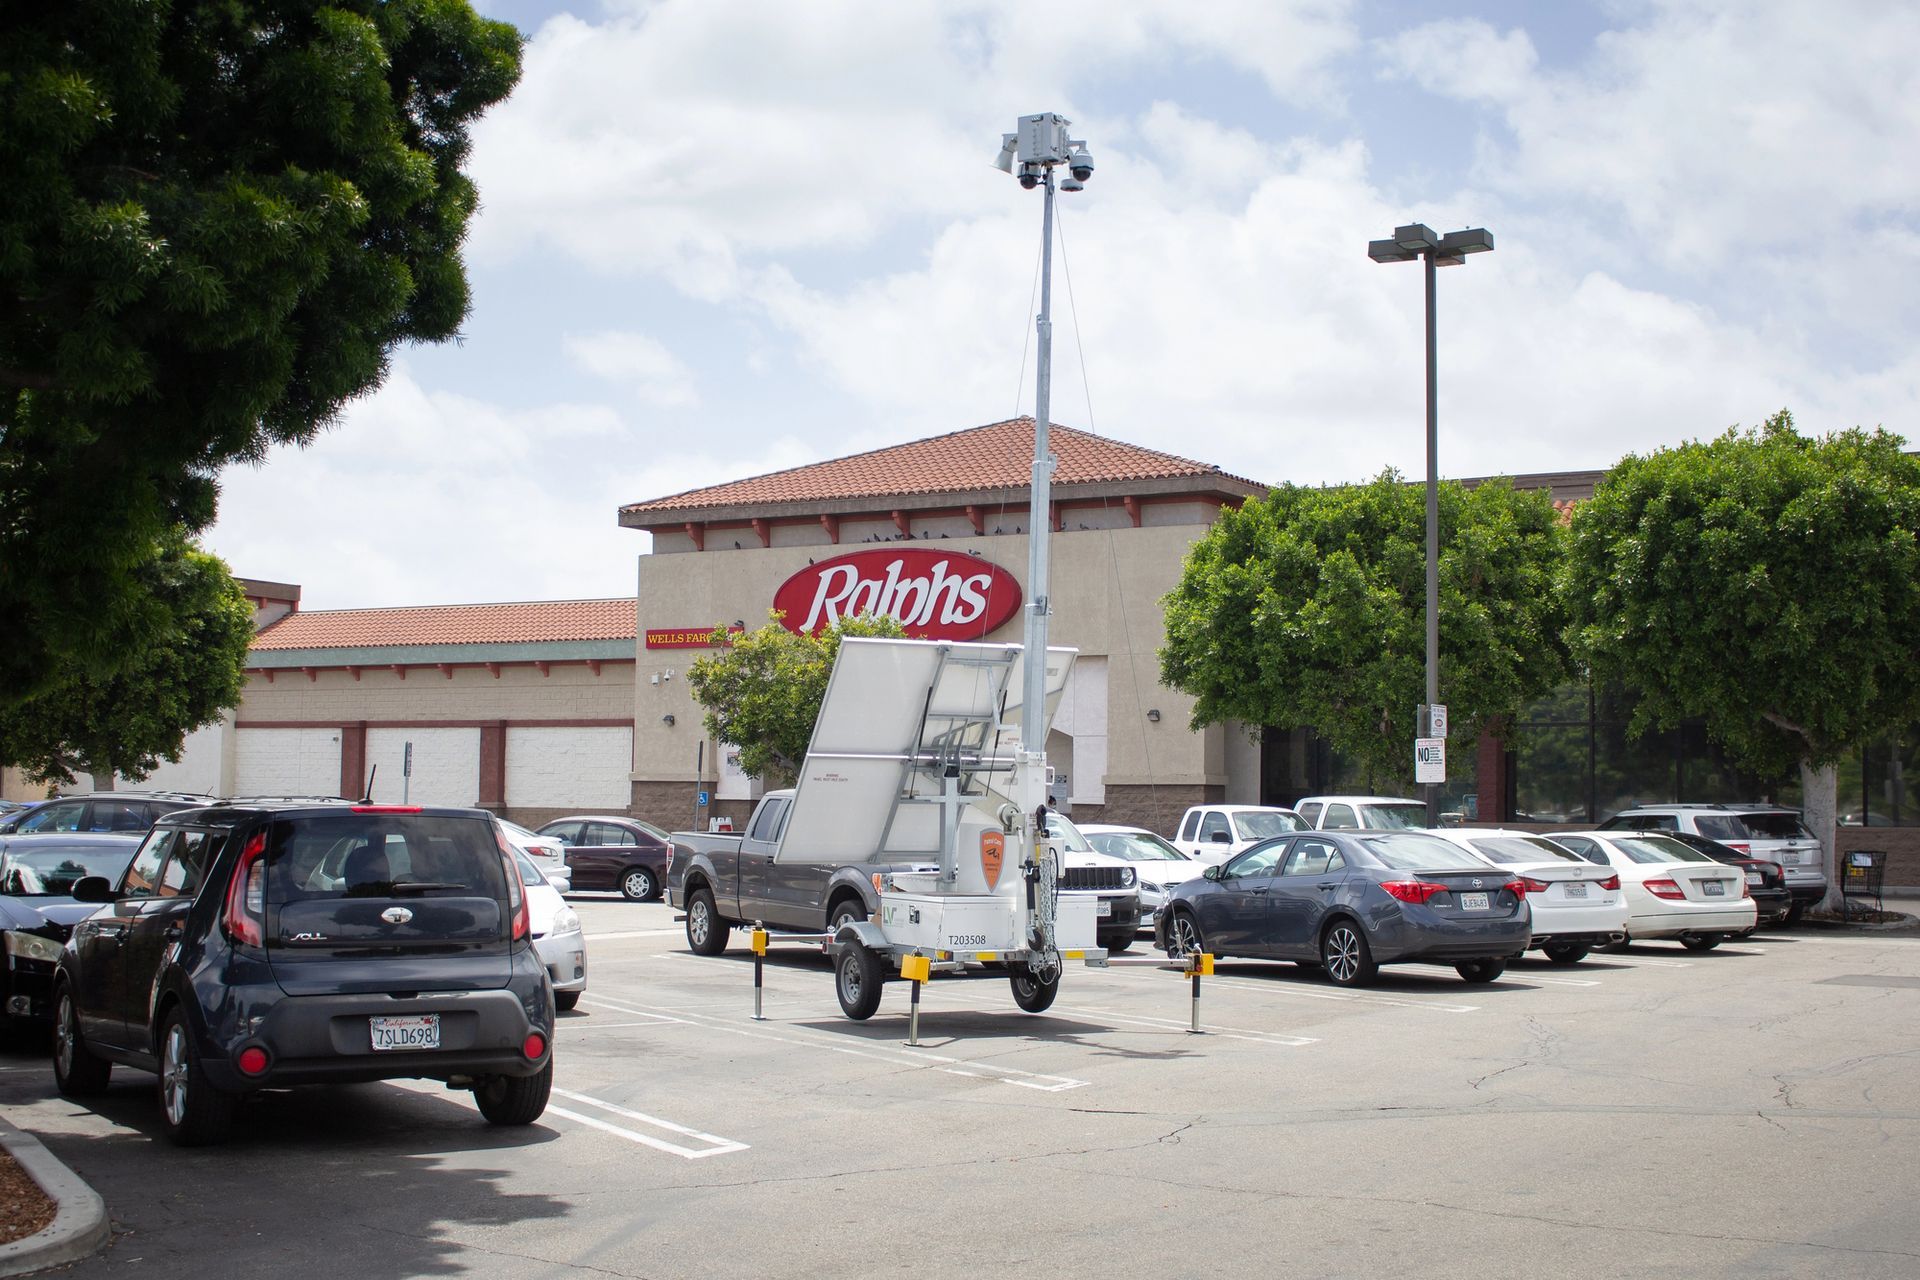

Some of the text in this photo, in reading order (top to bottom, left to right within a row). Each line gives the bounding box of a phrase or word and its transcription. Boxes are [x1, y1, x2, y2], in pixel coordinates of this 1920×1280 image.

[799, 559, 992, 631] Ralphs
[648, 633, 684, 644] WELLS
[1418, 747, 1430, 762] NO
[948, 935, 986, 945] T203508
[385, 1019, 420, 1028] California
[377, 1028, 433, 1045] 7SLD698
